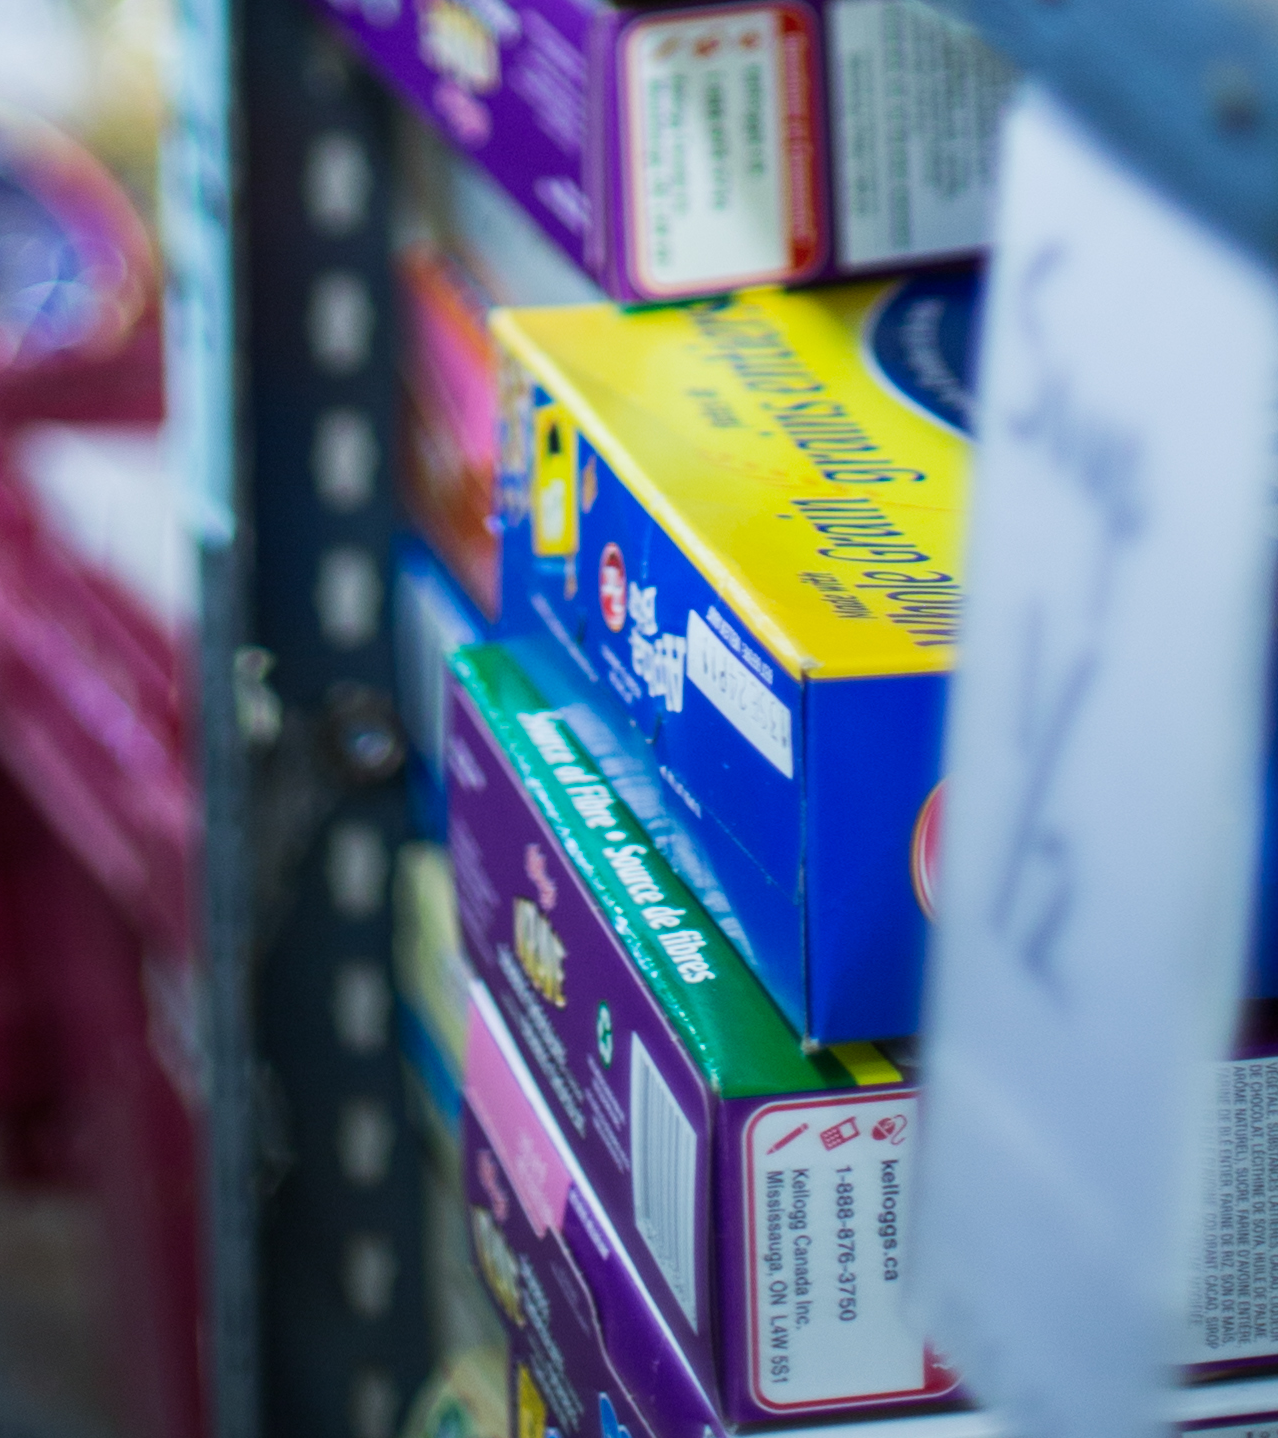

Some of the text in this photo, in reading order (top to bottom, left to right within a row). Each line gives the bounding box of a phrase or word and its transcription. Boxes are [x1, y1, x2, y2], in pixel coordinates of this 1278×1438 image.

[776, 498, 931, 563] Grain
[603, 844, 665, 905] Source
[641, 905, 688, 930] de
[657, 930, 716, 984] fibres
[789, 1168, 813, 1330] Kellogg Canada Inc.
[835, 1165, 857, 1322] 1-888-876-3750
[878, 1159, 900, 1281] kelloggs.ca
[764, 1170, 790, 1384] Mississauga, ON L4W 5S1
